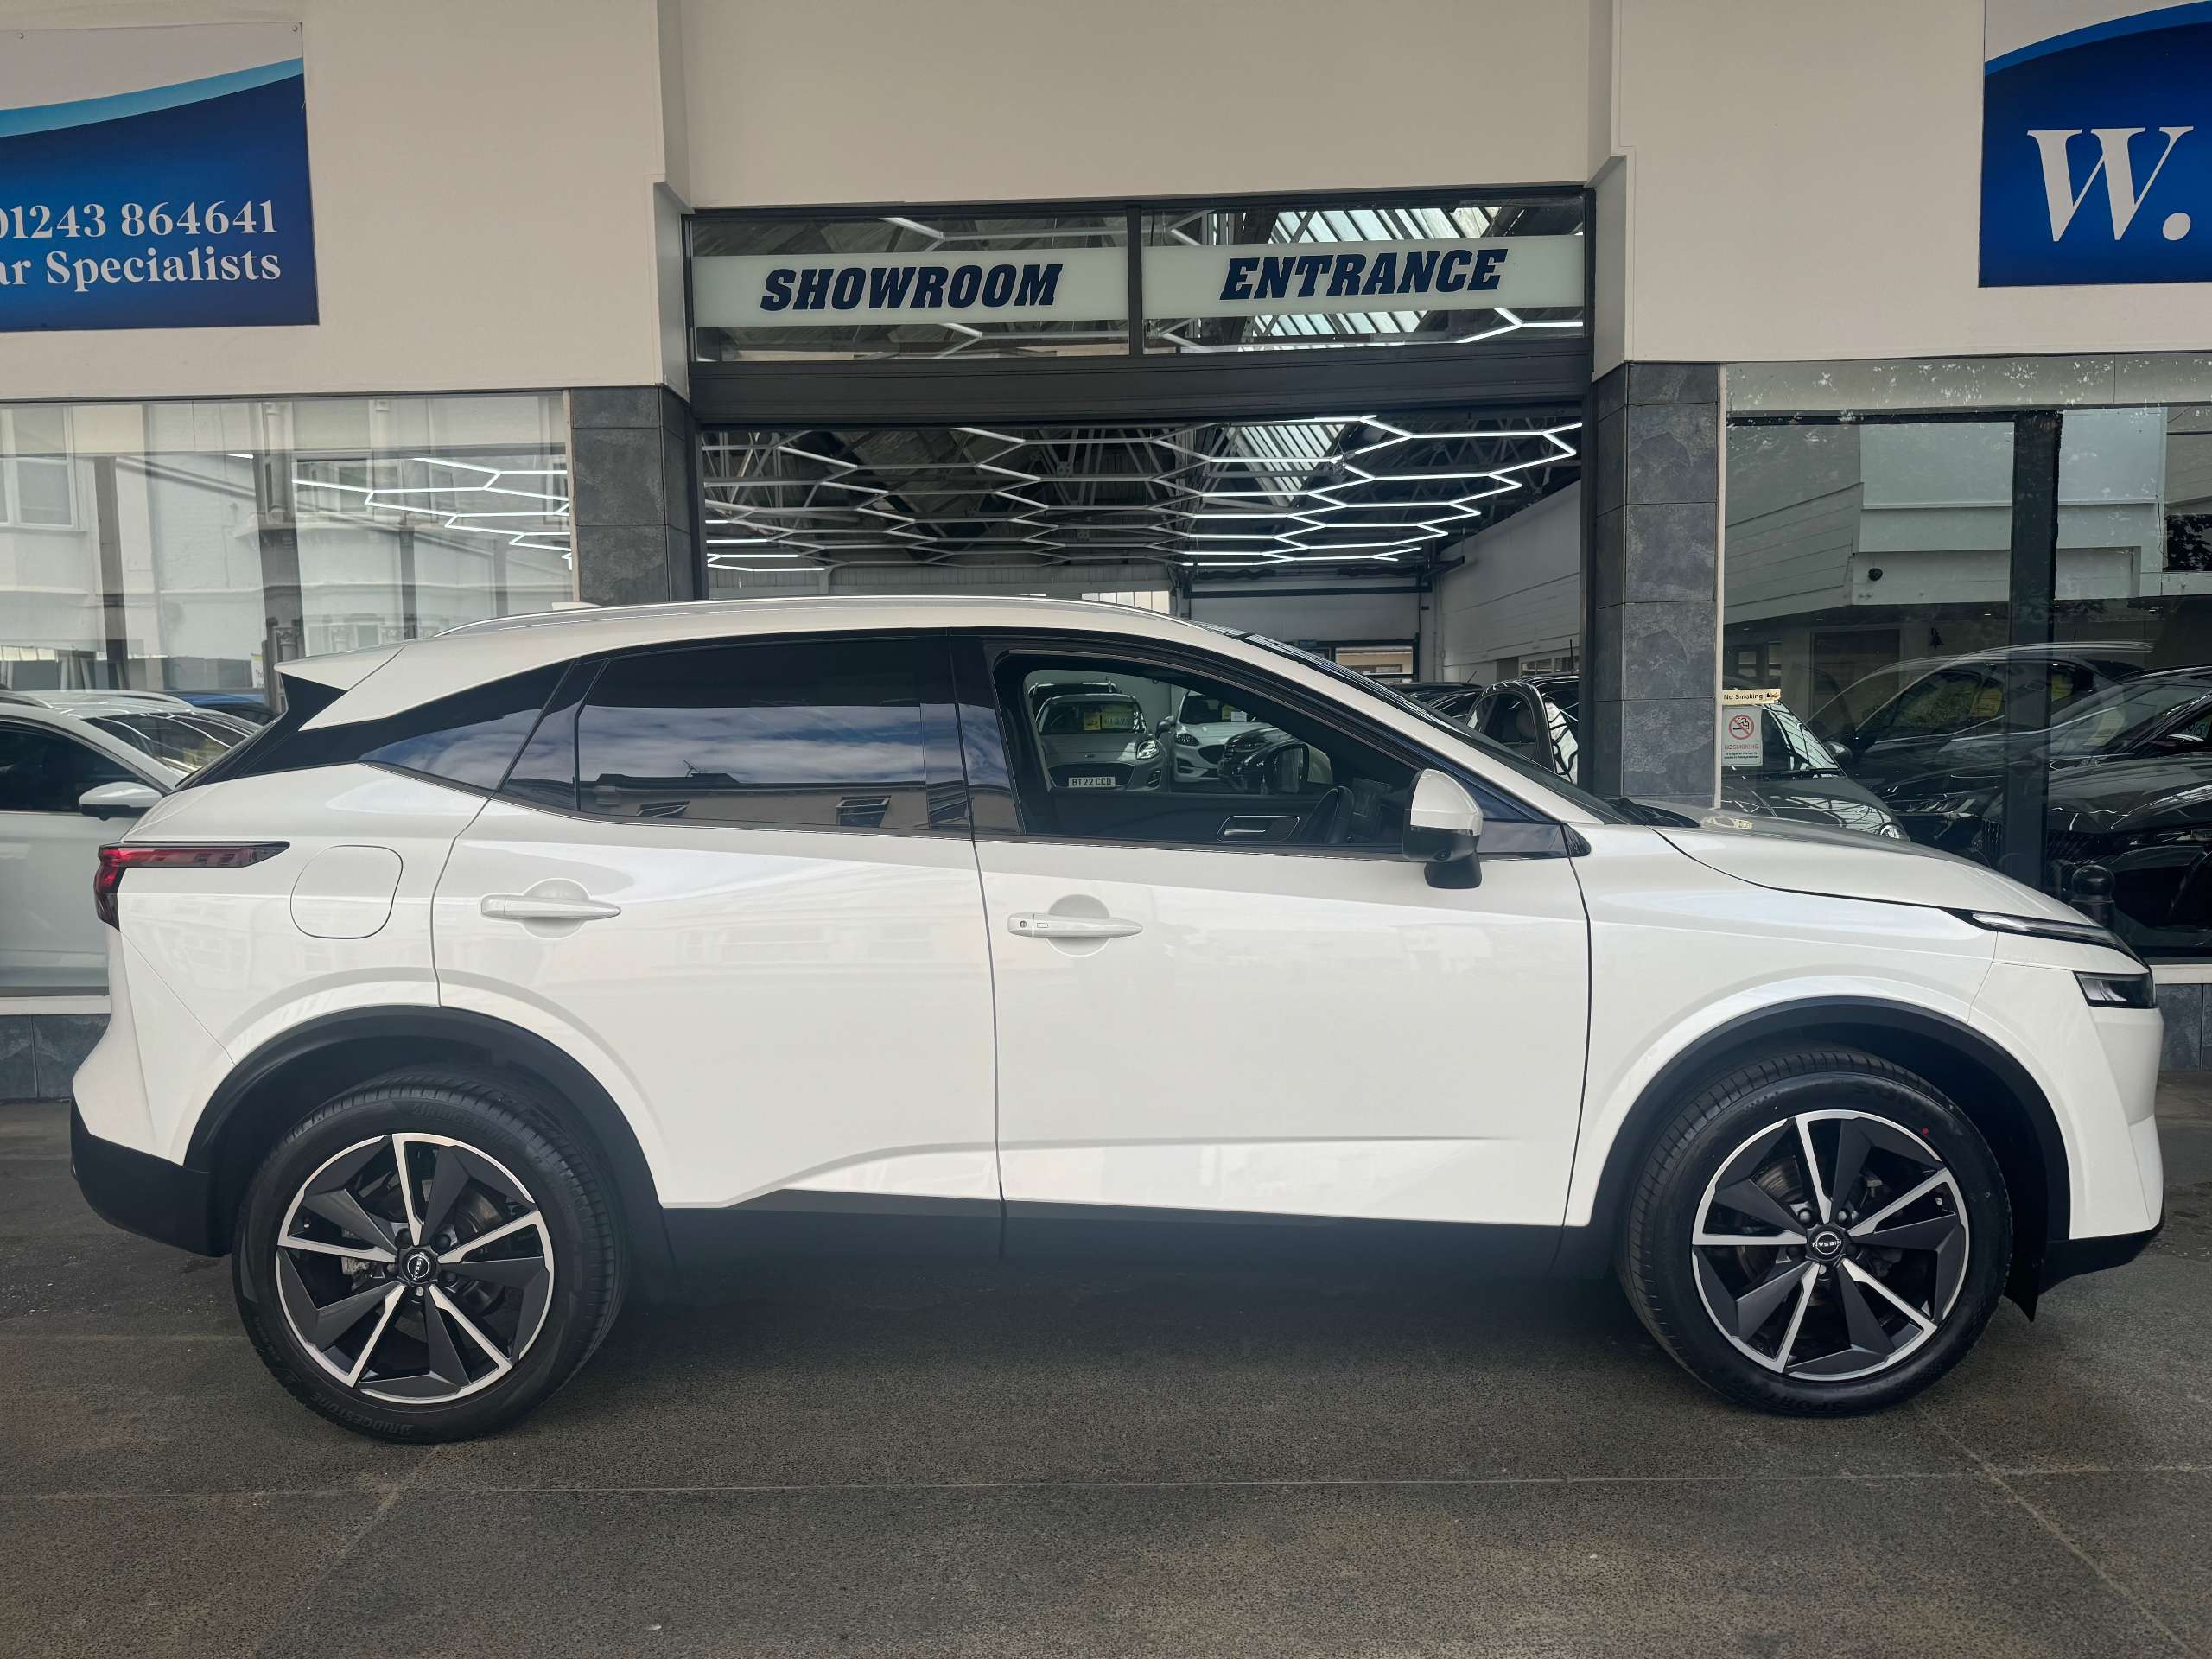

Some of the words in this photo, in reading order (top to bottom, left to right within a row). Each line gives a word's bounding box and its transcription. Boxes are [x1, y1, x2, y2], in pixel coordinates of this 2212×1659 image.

[2026, 126, 2194, 242] W.
[121, 200, 277, 237] 864641
[46, 245, 281, 293] Specialists
[760, 263, 1063, 312] SHOWROOM
[1219, 248, 1509, 301] ENTRANCE
[1071, 778, 1093, 786] BT22
[1812, 1239, 1841, 1249] NISSAN
[413, 1251, 425, 1281] NISSAN
[310, 1391, 416, 1436] BRIDGESTONE
